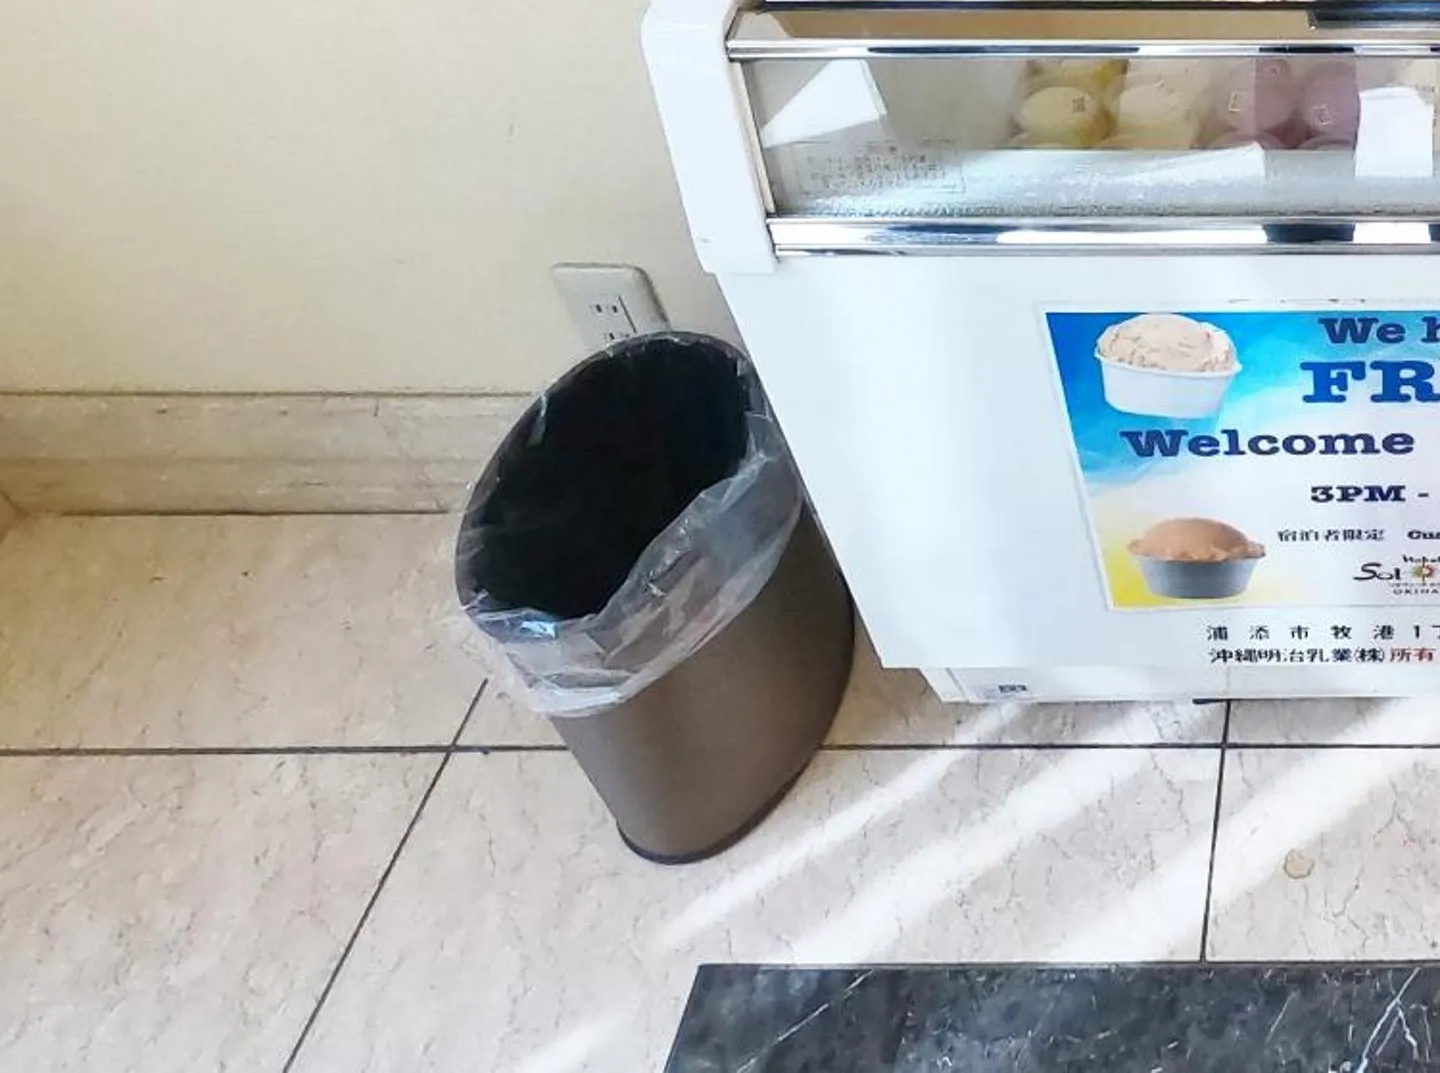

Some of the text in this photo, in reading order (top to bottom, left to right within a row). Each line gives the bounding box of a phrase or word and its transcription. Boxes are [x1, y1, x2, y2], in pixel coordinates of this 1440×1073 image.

[1320, 315, 1407, 345] We
[1121, 425, 1416, 458] Welcome
[1310, 485, 1406, 503] 3PM
[1353, 562, 1401, 581] Sol
